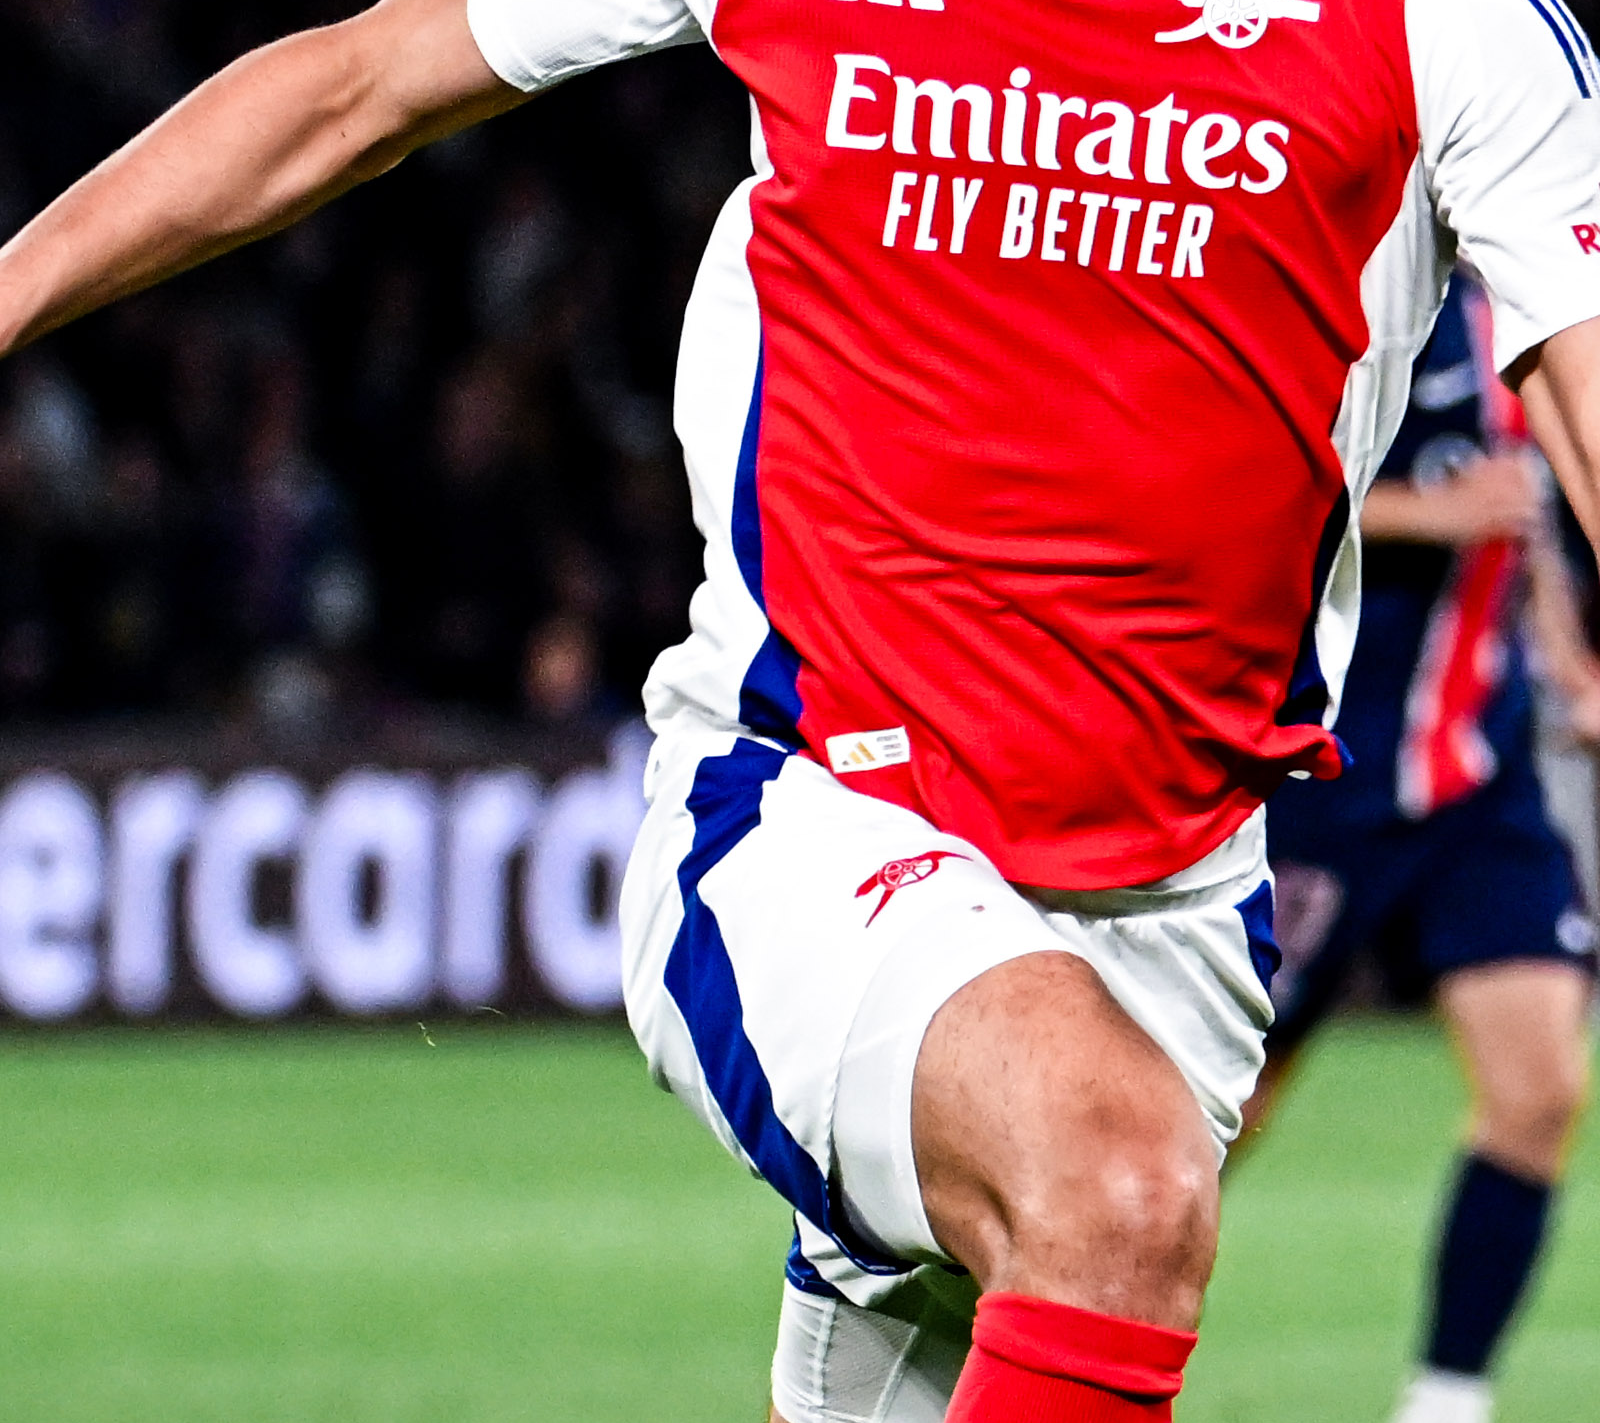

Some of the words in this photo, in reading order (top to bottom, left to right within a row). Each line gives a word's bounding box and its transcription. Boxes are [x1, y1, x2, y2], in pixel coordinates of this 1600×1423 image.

[825, 53, 1289, 194] Emirates
[882, 171, 983, 254] FLY
[999, 183, 1214, 277] BETTER
